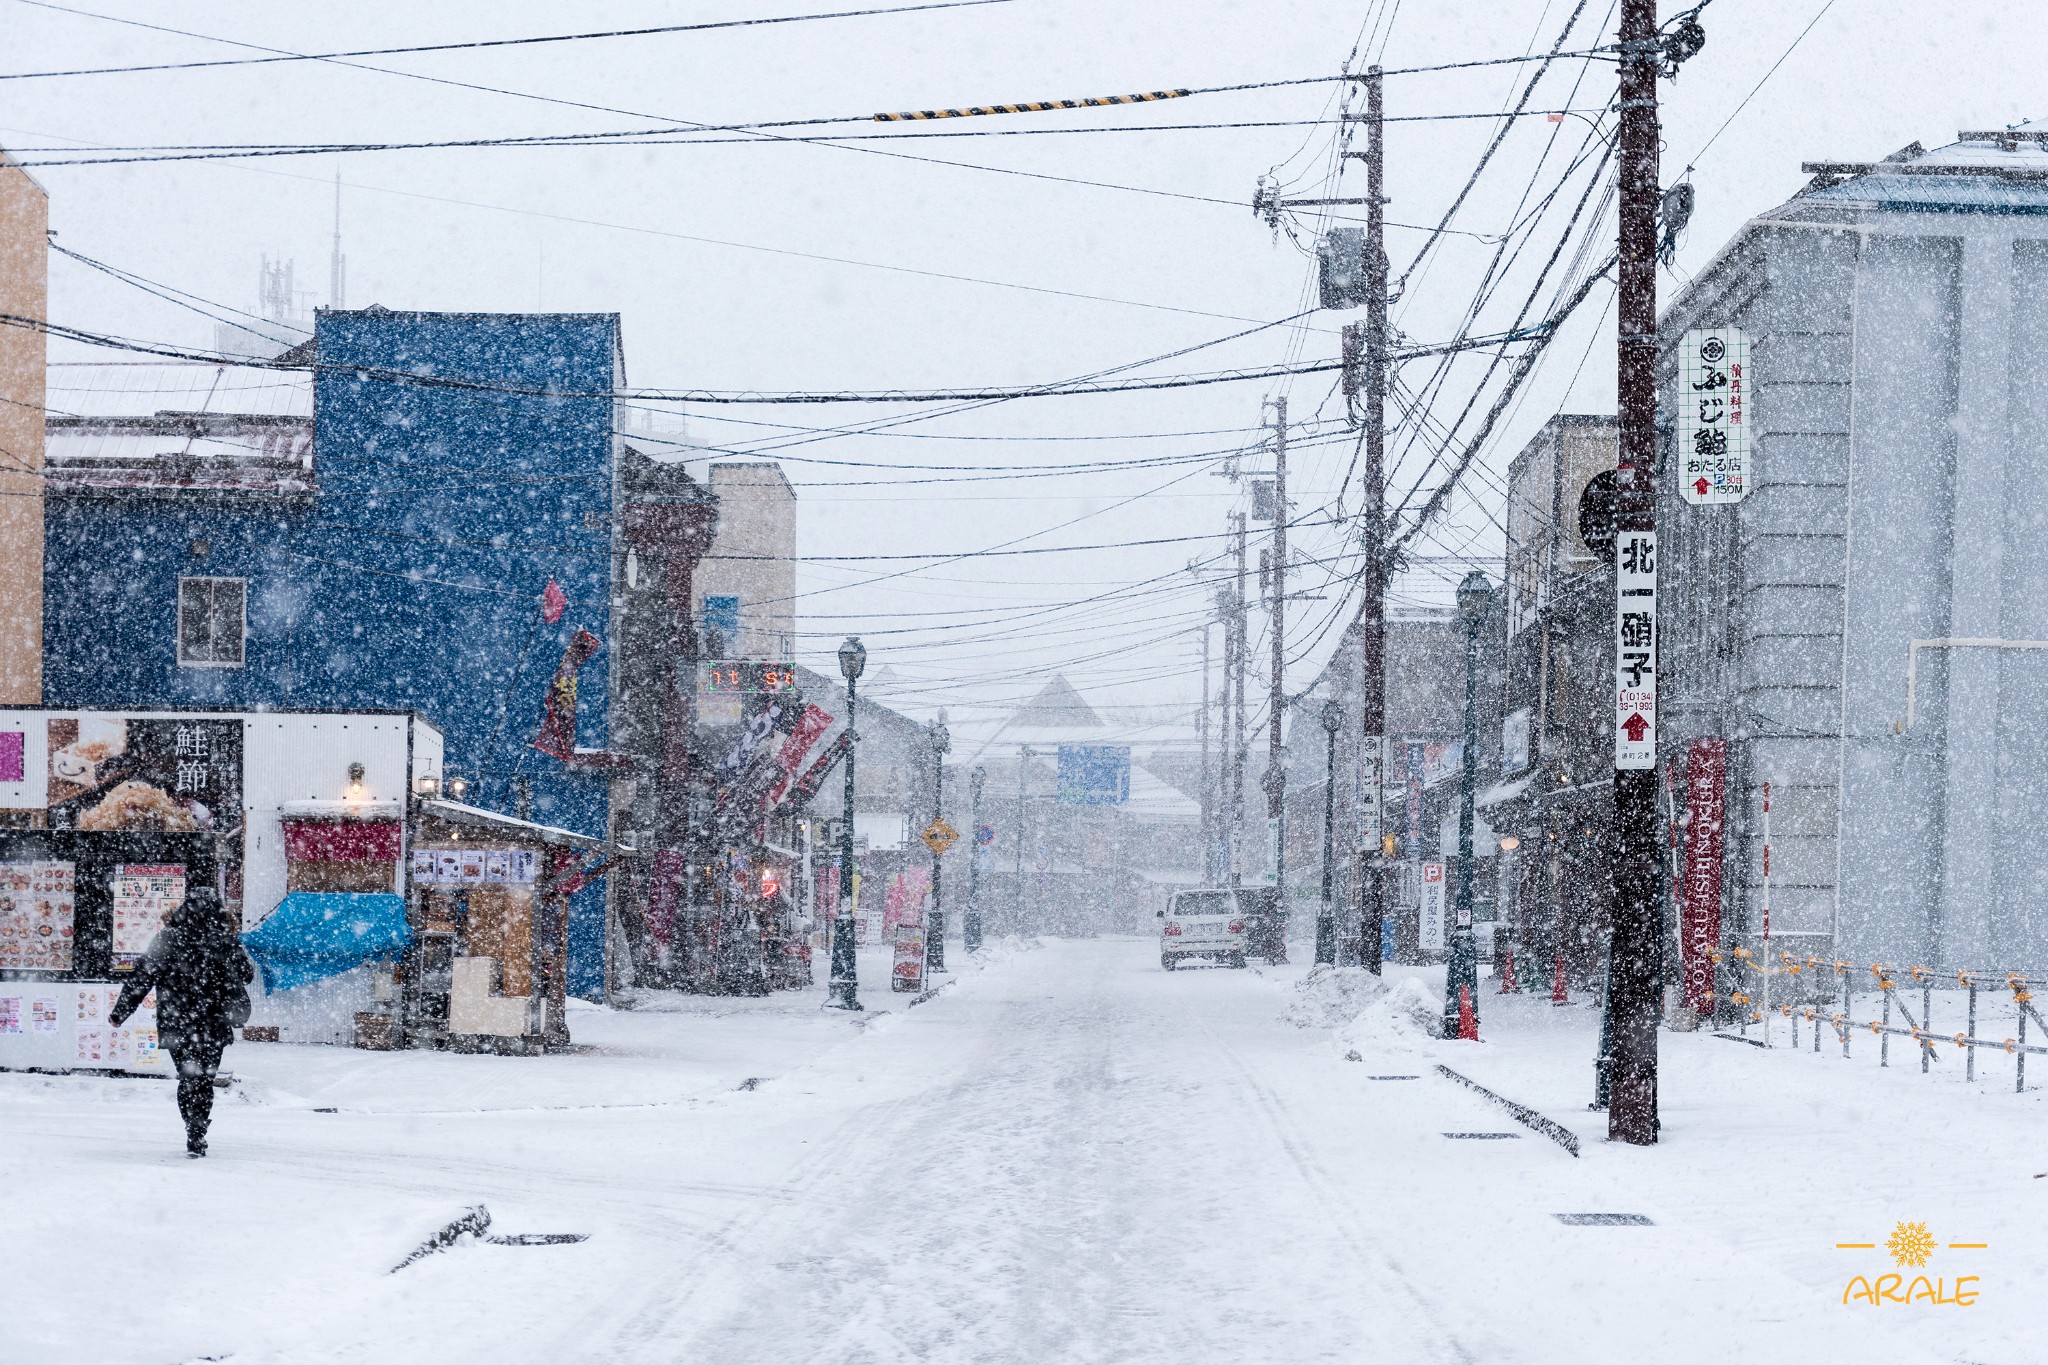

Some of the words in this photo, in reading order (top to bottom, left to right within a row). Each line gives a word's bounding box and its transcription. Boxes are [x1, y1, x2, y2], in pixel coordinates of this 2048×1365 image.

[1688, 457, 1742, 473] おたる店
[1715, 485, 1743, 495] 150M
[1621, 538, 1653, 688] 北一硝子
[1626, 692, 1653, 701] (0134)
[1619, 702, 1653, 711] 33-1993
[175, 725, 208, 792] 鮭節
